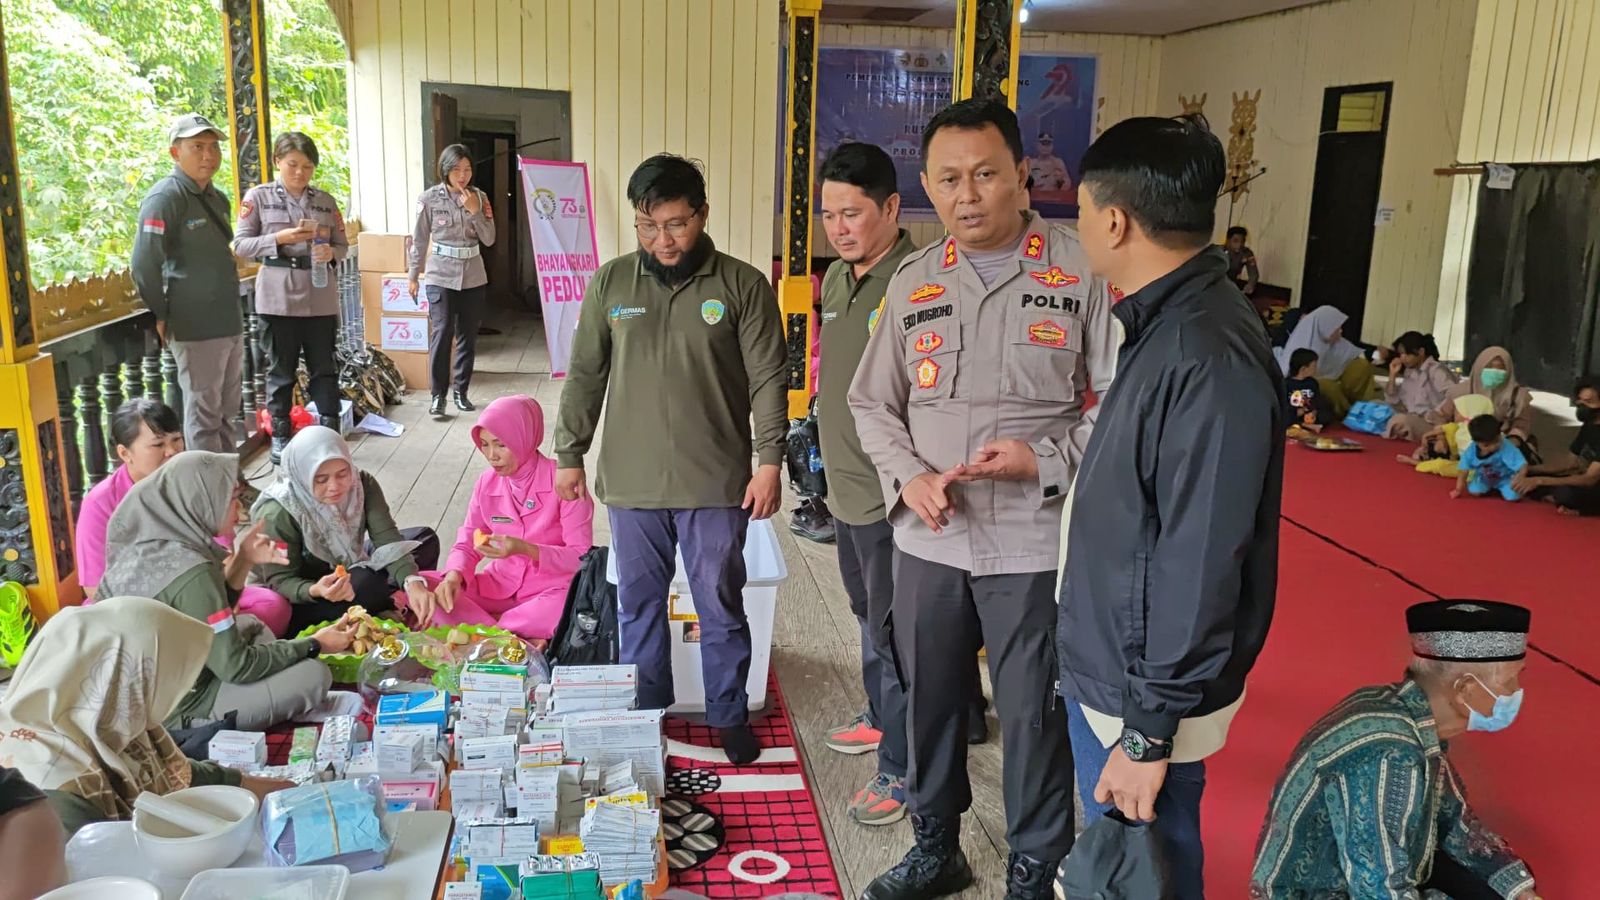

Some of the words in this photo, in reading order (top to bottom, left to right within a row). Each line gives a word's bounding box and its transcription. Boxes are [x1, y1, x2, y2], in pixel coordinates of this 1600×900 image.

[559, 197, 578, 214] 73
[537, 253, 594, 272] BHAYANGKARI
[620, 307, 646, 315] GERMAS
[1021, 293, 1080, 314] POLRI
[917, 304, 953, 324] NUGROHO
